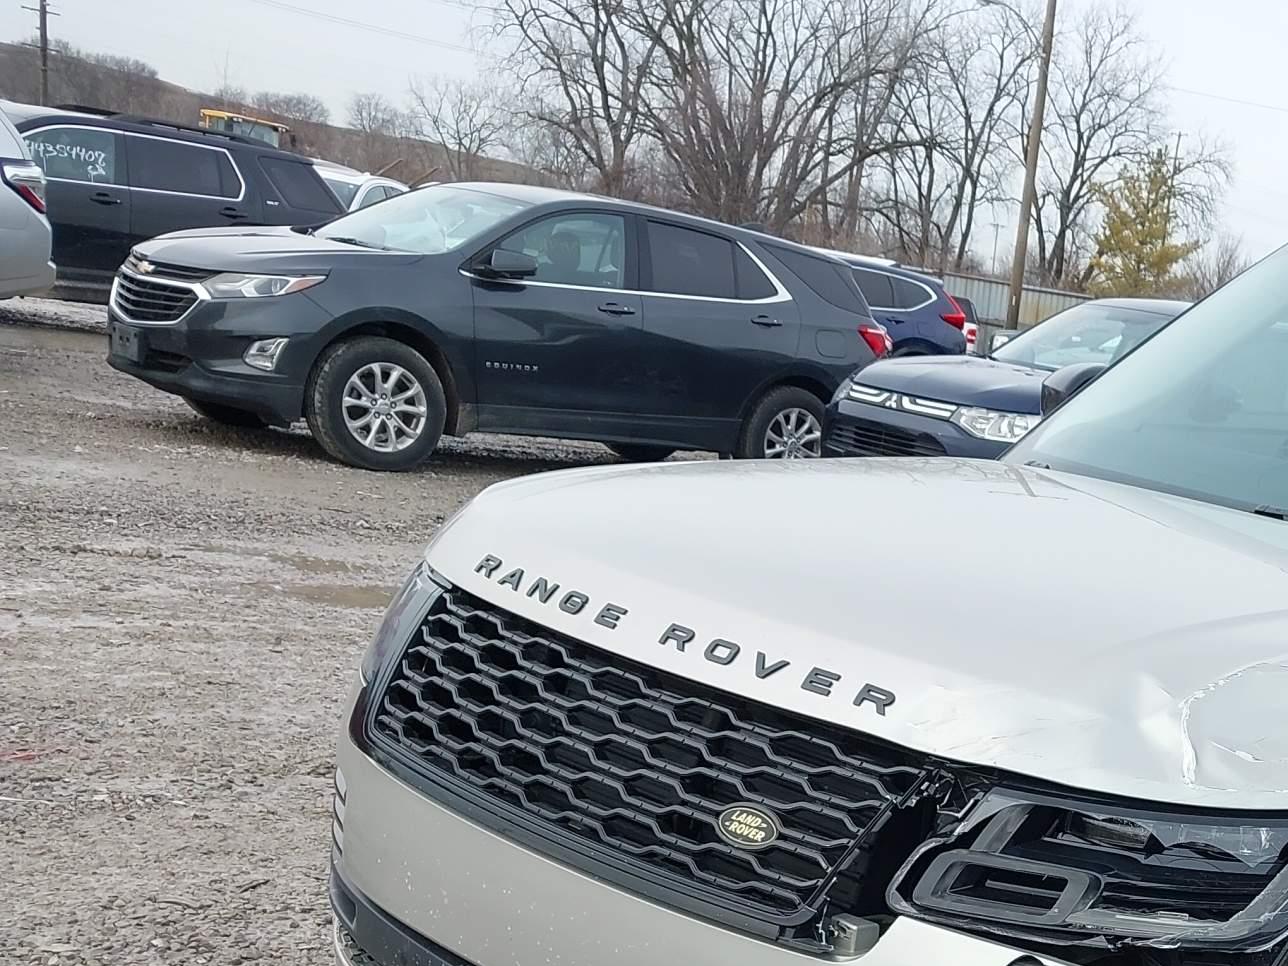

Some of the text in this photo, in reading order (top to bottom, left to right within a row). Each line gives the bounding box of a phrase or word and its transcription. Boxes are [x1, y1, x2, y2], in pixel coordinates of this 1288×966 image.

[485, 361, 538, 371] EQUINOX
[473, 553, 897, 716] RANGE ROVER
[730, 810, 762, 827] LAND
[728, 821, 766, 842] ROVER
